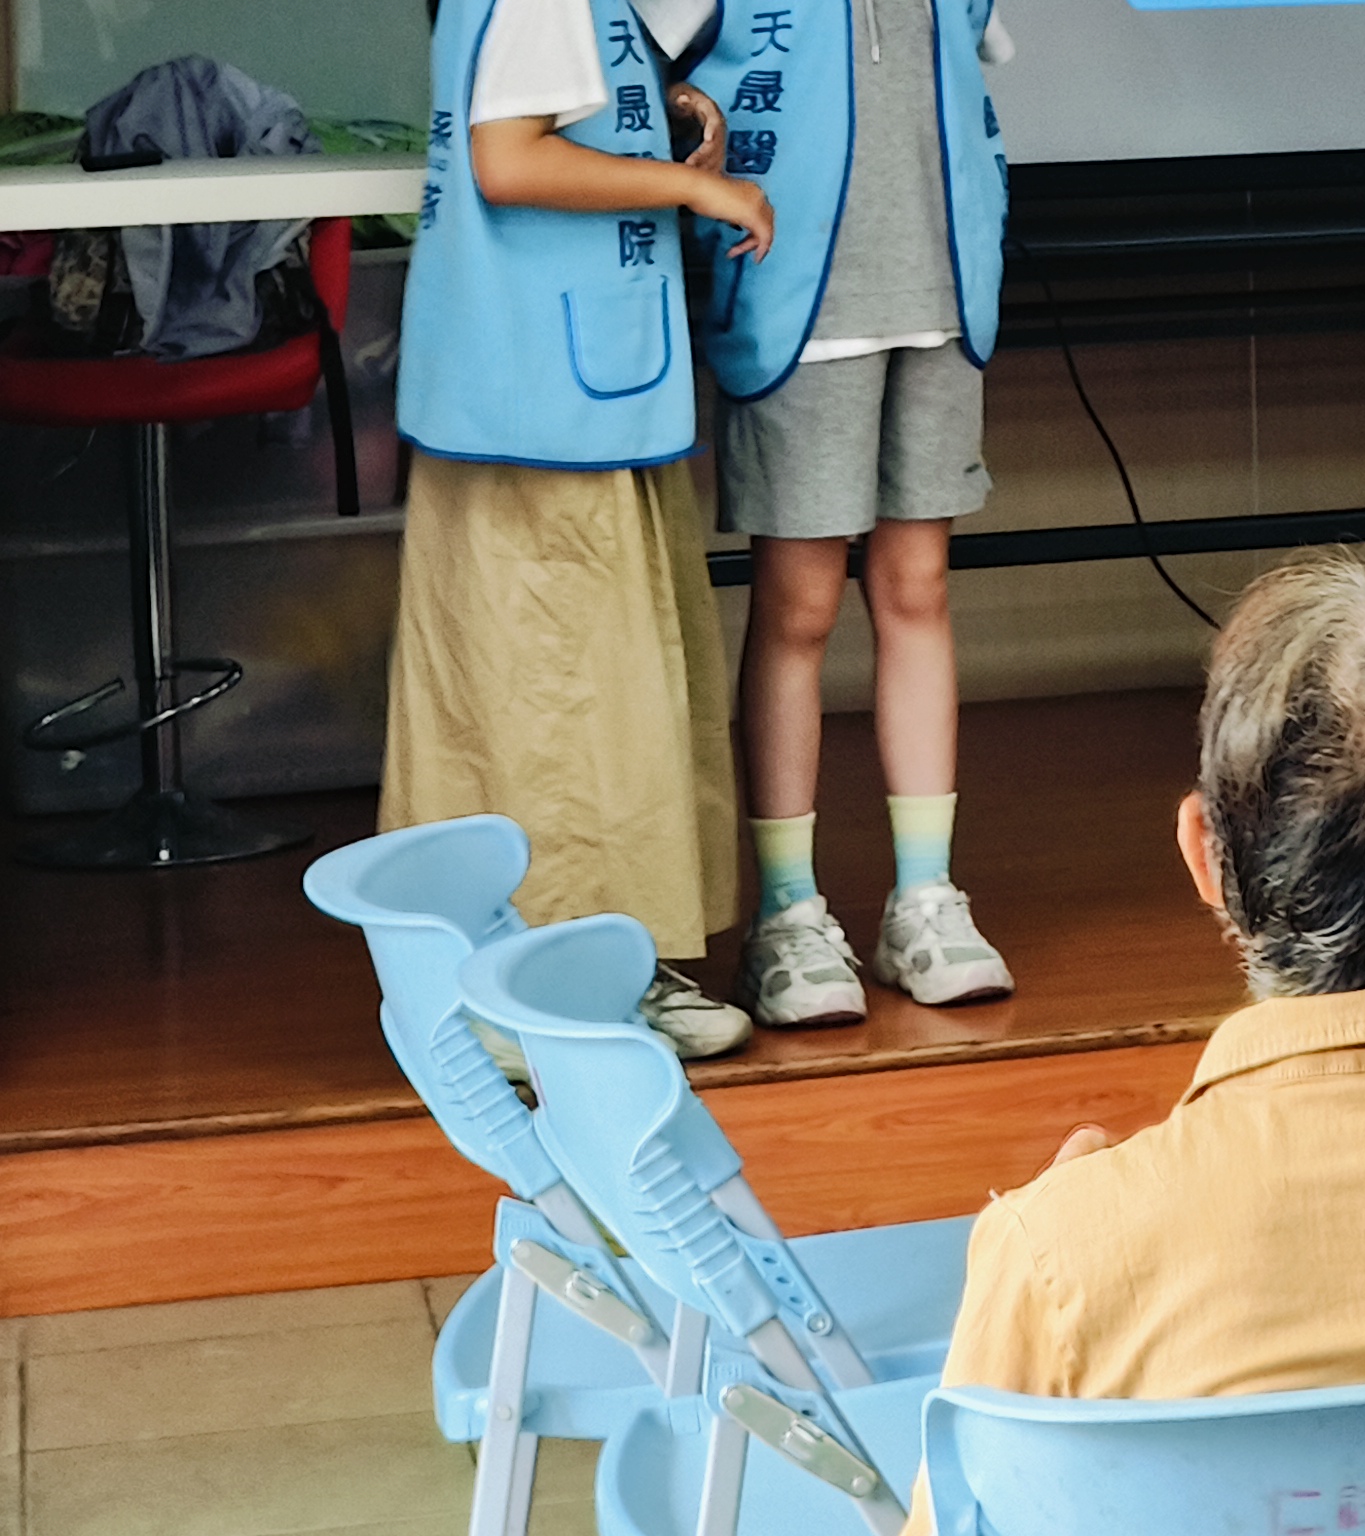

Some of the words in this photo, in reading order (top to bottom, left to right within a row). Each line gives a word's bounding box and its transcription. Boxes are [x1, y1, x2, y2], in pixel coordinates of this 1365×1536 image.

[608, 19, 657, 268] 天晟院
[727, 9, 793, 175] 天晟醫
